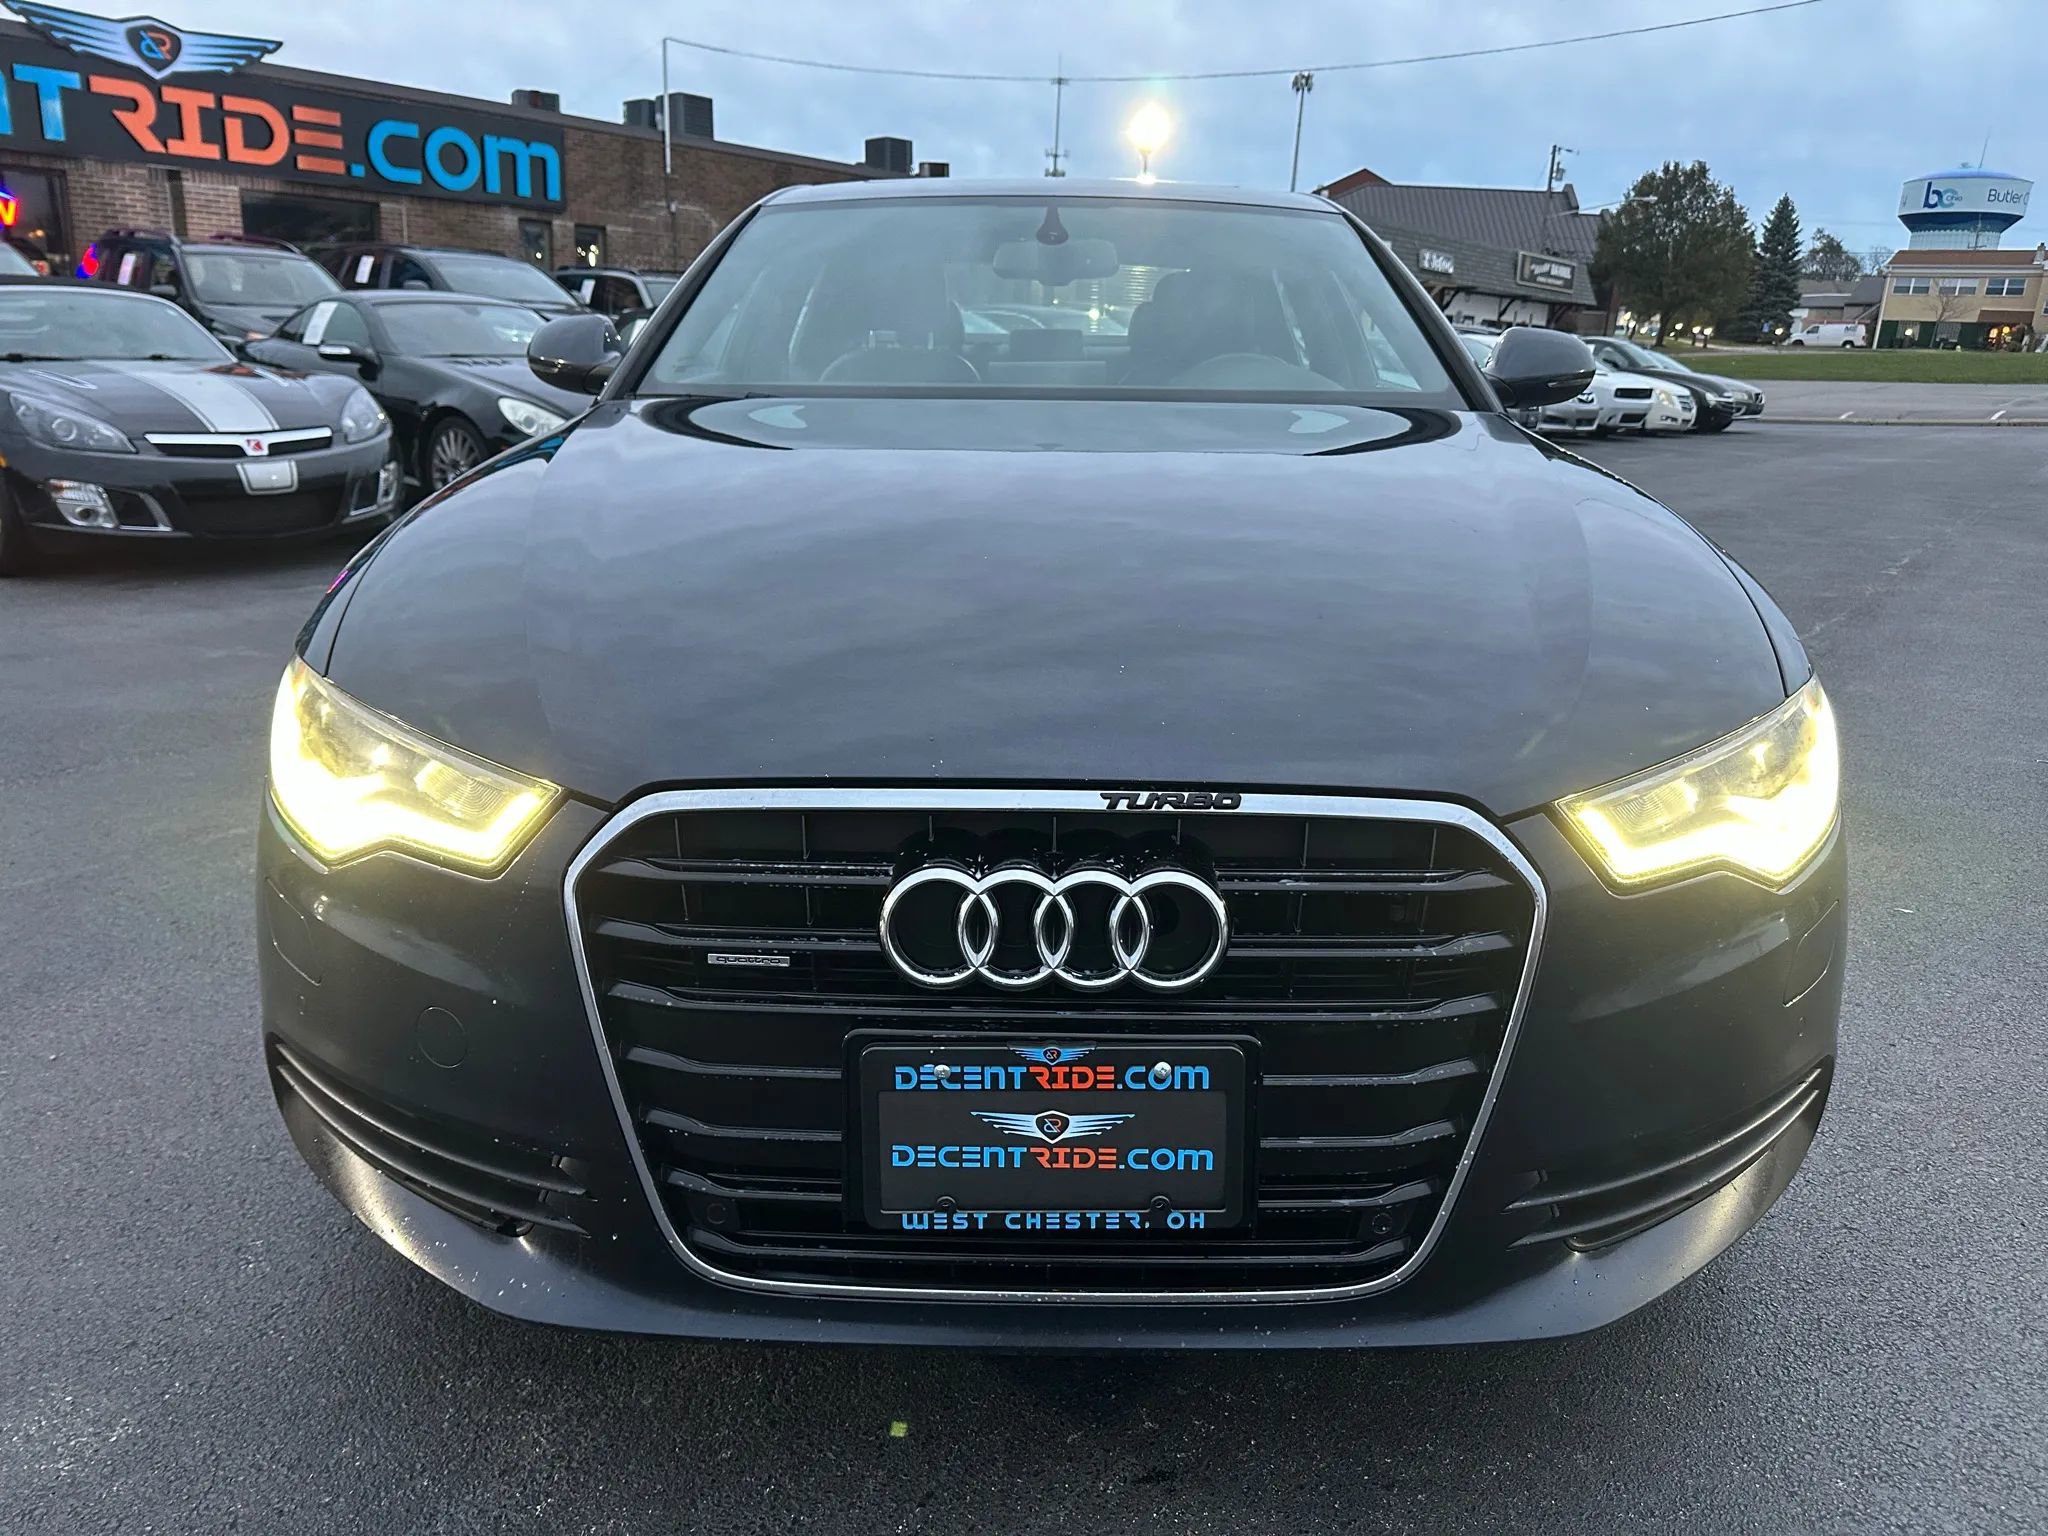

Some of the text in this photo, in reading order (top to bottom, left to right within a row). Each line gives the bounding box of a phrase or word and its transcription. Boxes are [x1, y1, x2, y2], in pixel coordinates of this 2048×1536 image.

[1987, 188, 2022, 204] Butler
[1100, 792, 1242, 810] TURBO
[716, 955, 781, 965] quattro
[901, 1211, 1206, 1230] WEST CHESTER, OH
